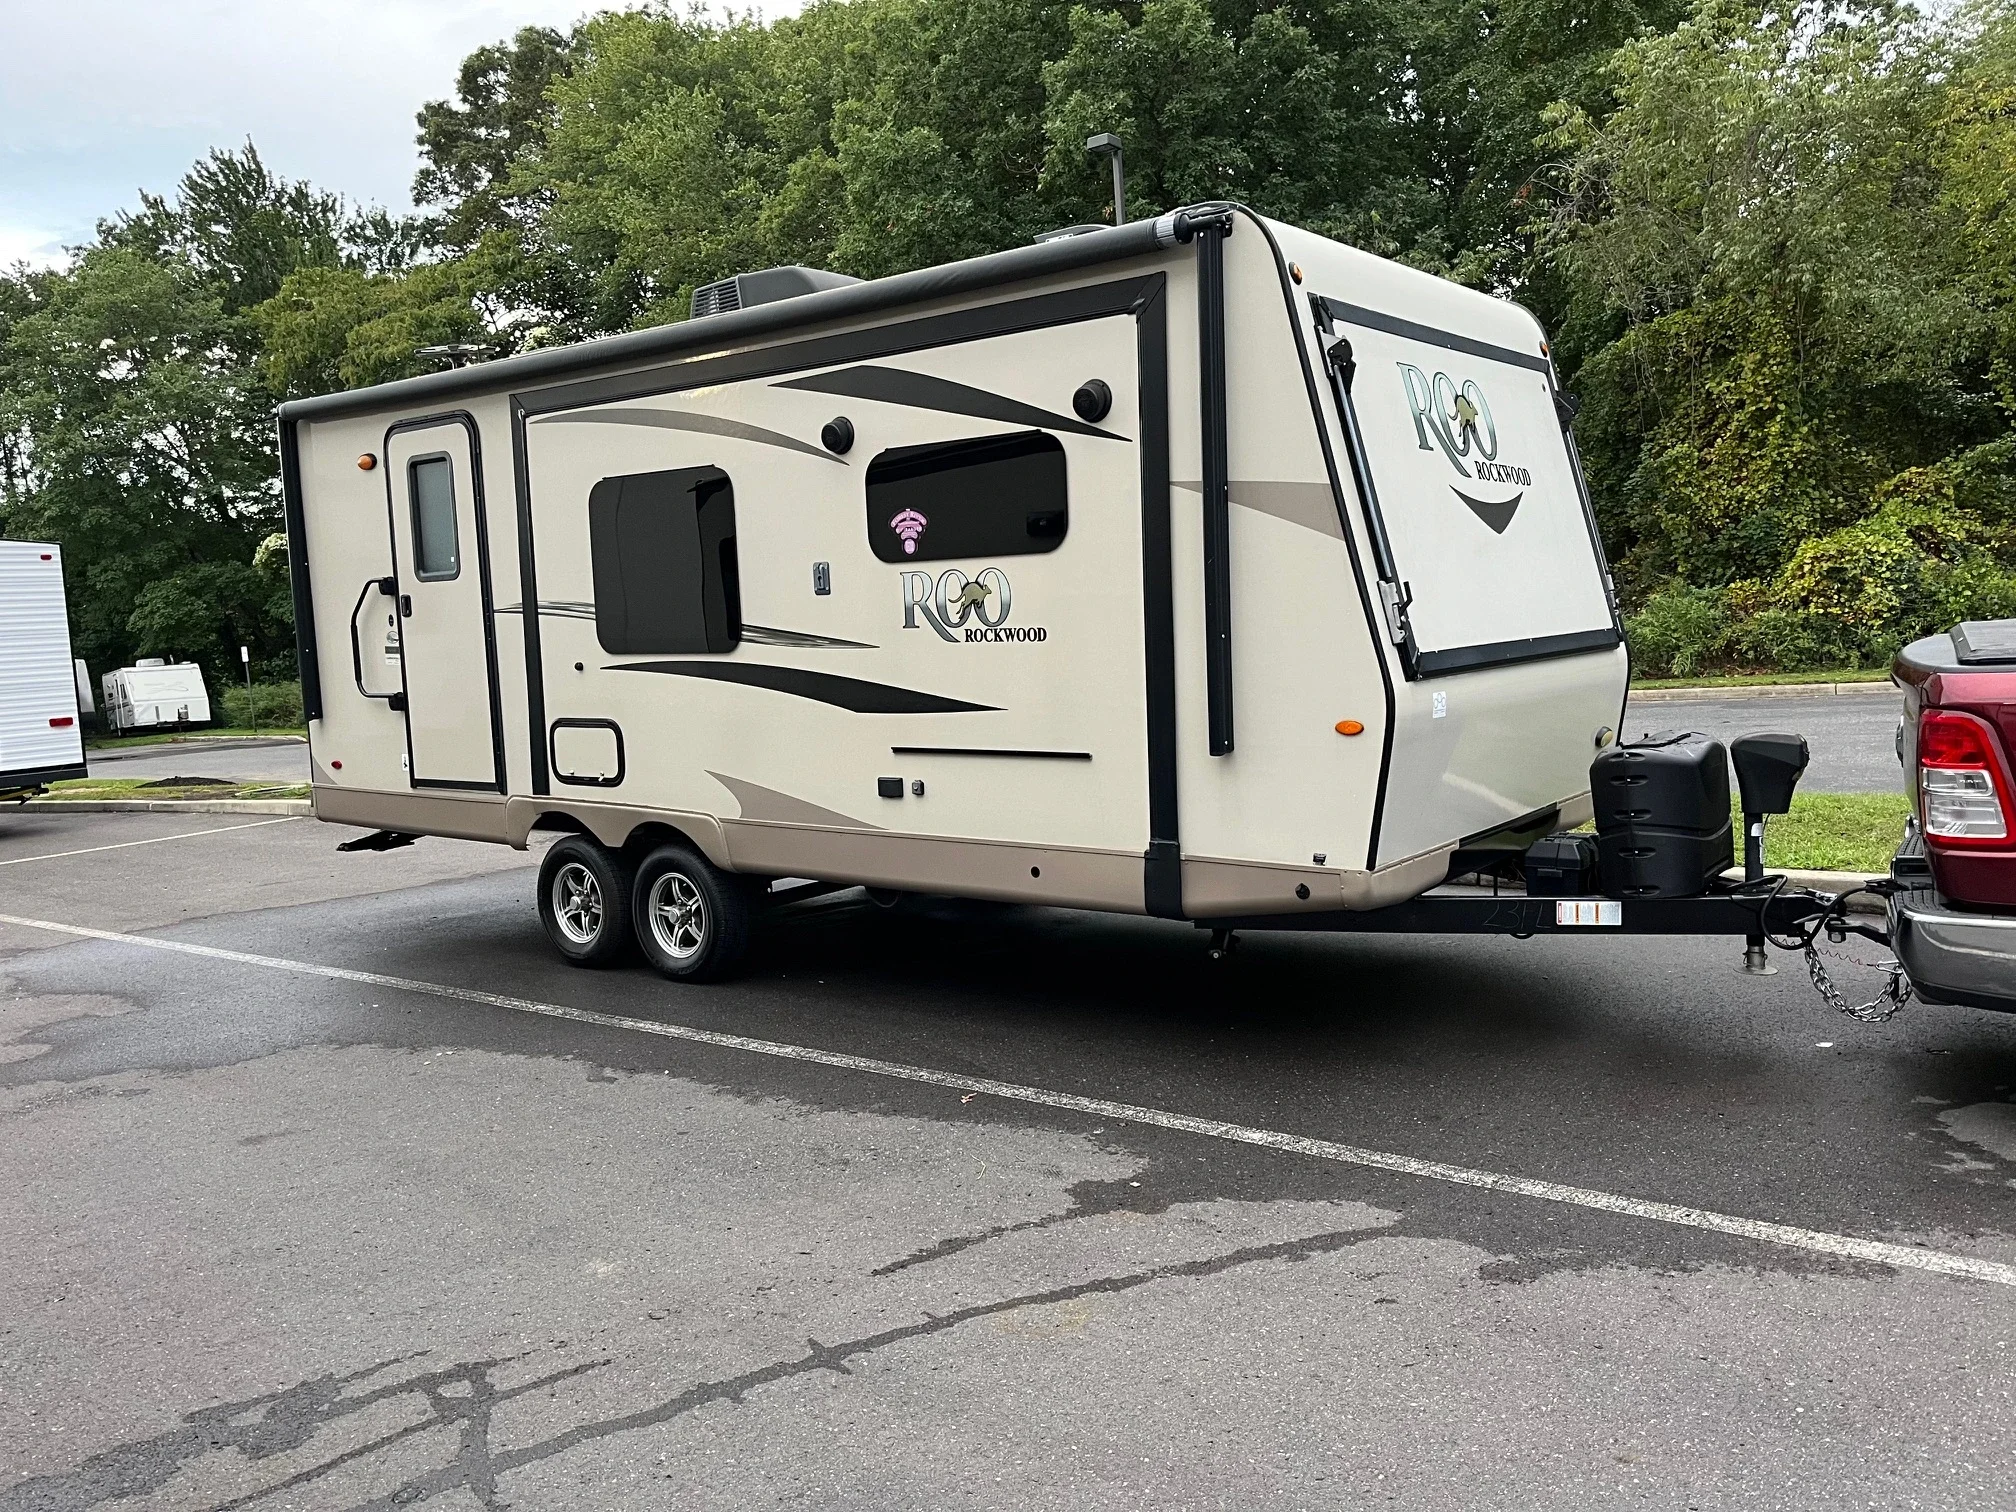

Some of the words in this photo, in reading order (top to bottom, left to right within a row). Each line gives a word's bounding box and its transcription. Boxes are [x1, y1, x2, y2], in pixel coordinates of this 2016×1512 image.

[1396, 361, 1498, 478] ROO
[1474, 460, 1532, 486] ROCKWOOD
[899, 567, 1012, 643] ROO
[964, 627, 1048, 643] ROCKWOOD
